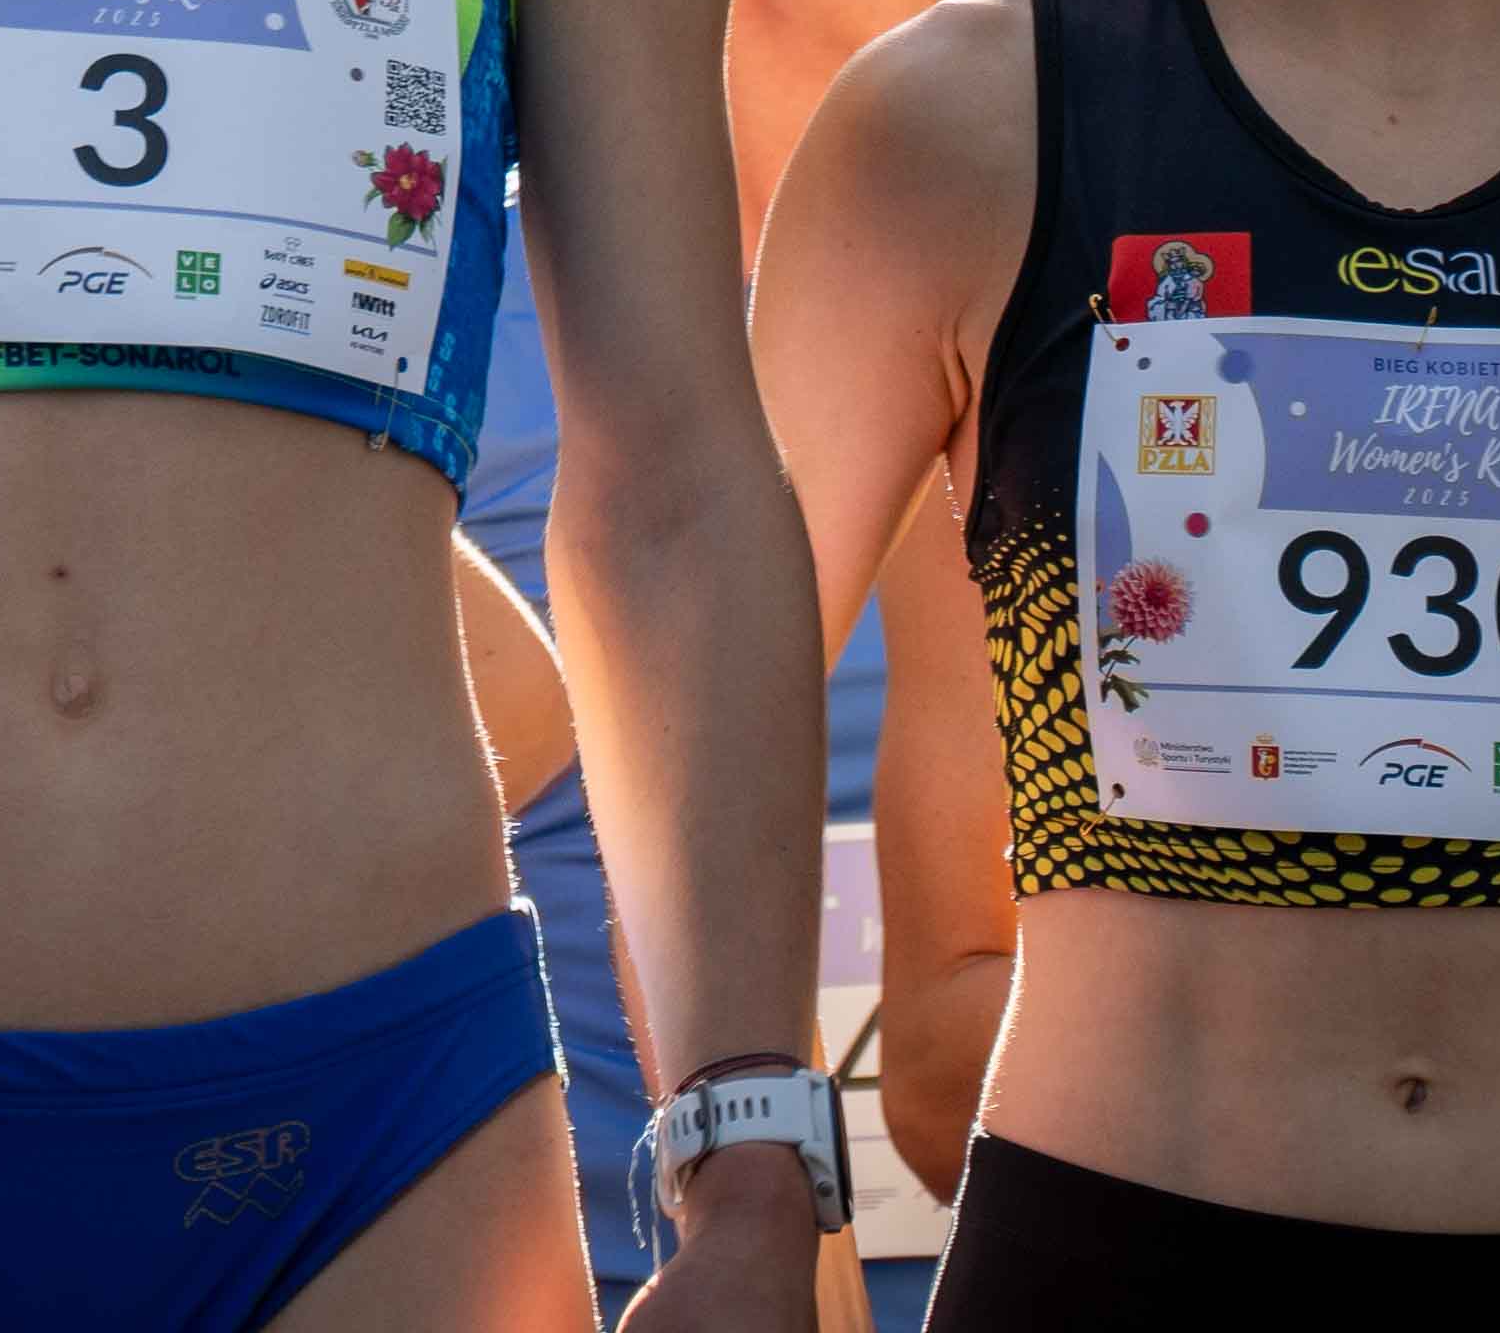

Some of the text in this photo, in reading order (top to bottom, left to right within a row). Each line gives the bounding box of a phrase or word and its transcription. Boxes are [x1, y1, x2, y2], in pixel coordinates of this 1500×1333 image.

[93, 8, 161, 27] 2025
[72, 53, 169, 187] 3
[57, 270, 129, 294] PGE
[1374, 357, 1418, 374] BIEG
[1143, 449, 1210, 471] PZLA
[1329, 431, 1469, 483] Women's
[1403, 488, 1470, 506] 2025
[1378, 763, 1449, 788] PGE
